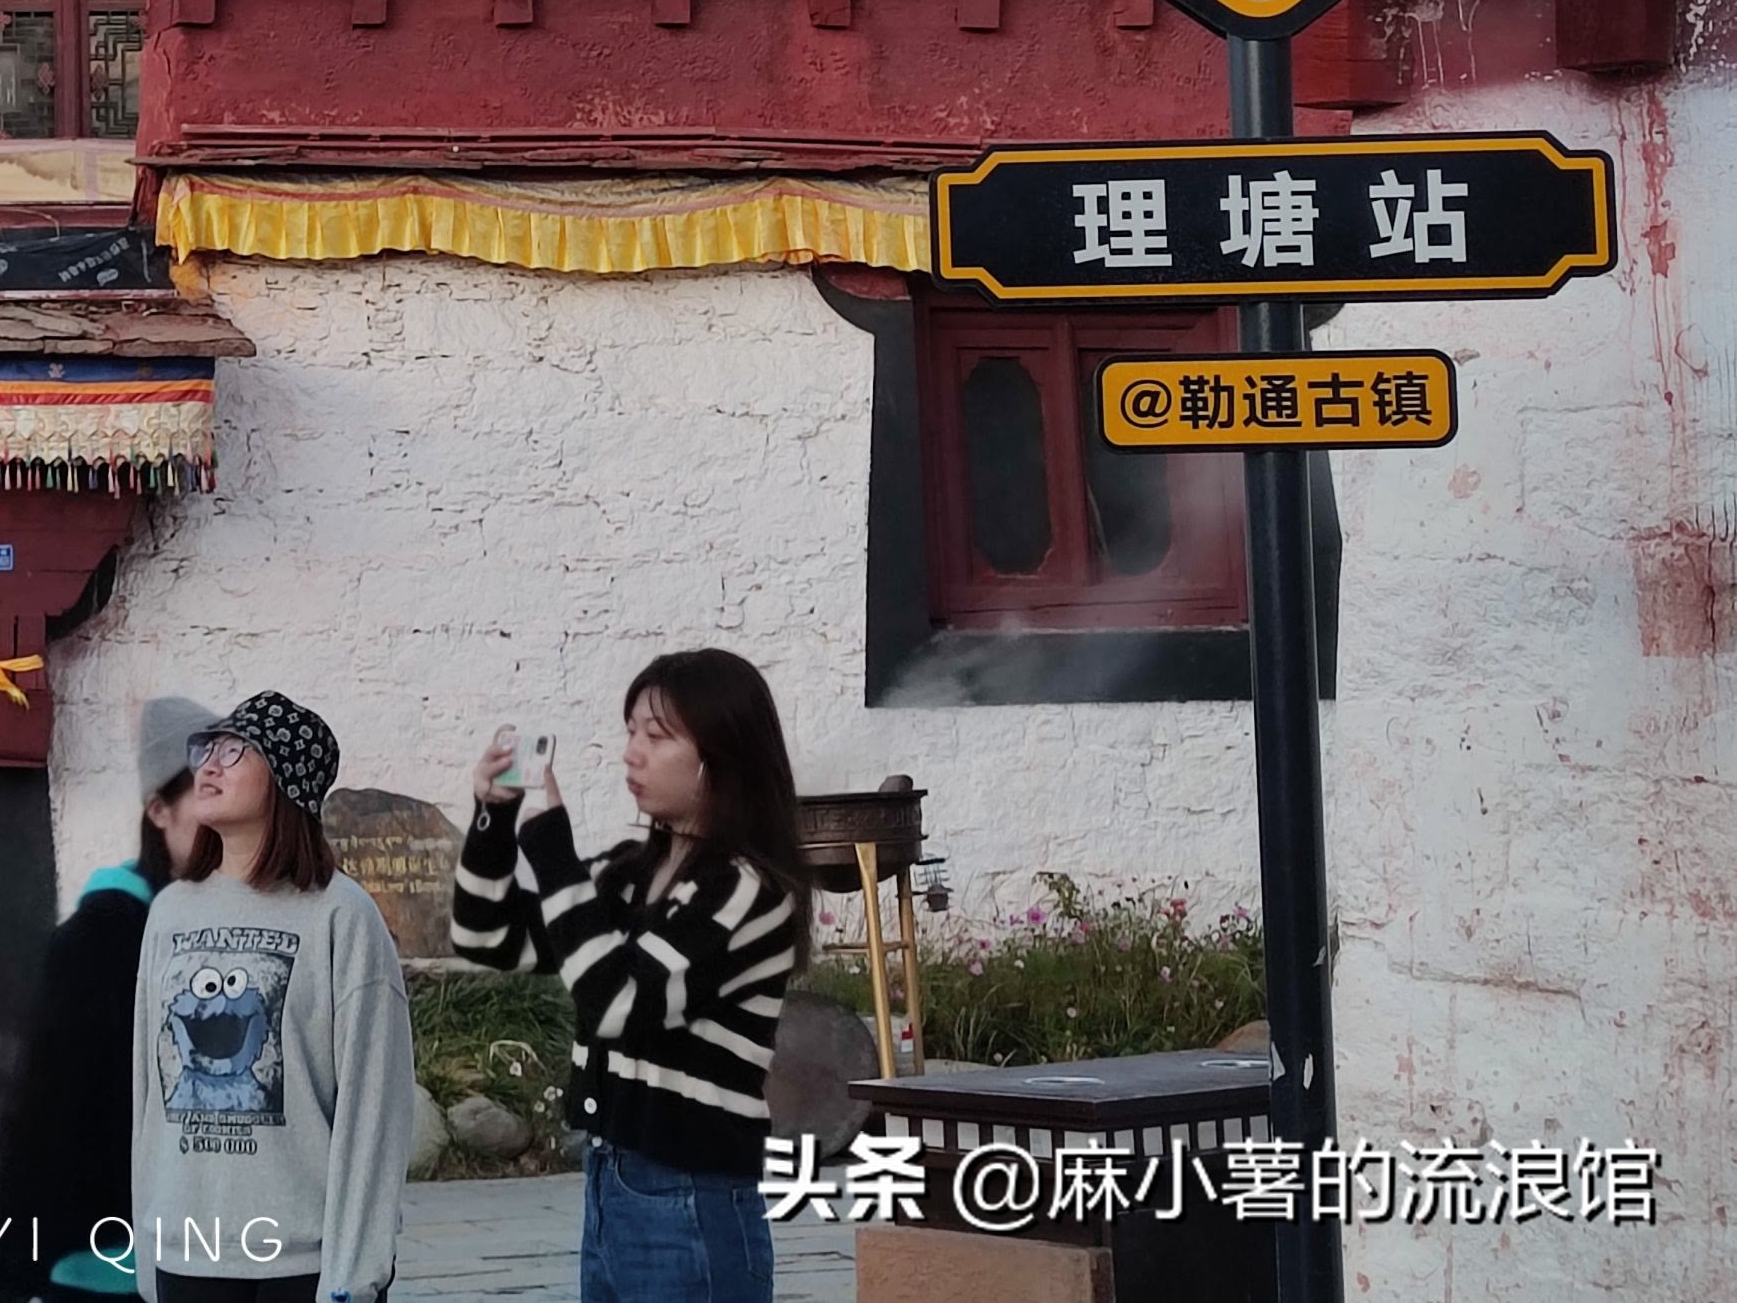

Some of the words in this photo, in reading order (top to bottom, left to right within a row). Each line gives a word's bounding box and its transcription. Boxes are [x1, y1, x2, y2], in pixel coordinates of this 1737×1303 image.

[1072, 168, 1470, 269] 理塘站
[1119, 370, 1434, 432] @勒通古镇
[172, 926, 300, 955] WANTED
